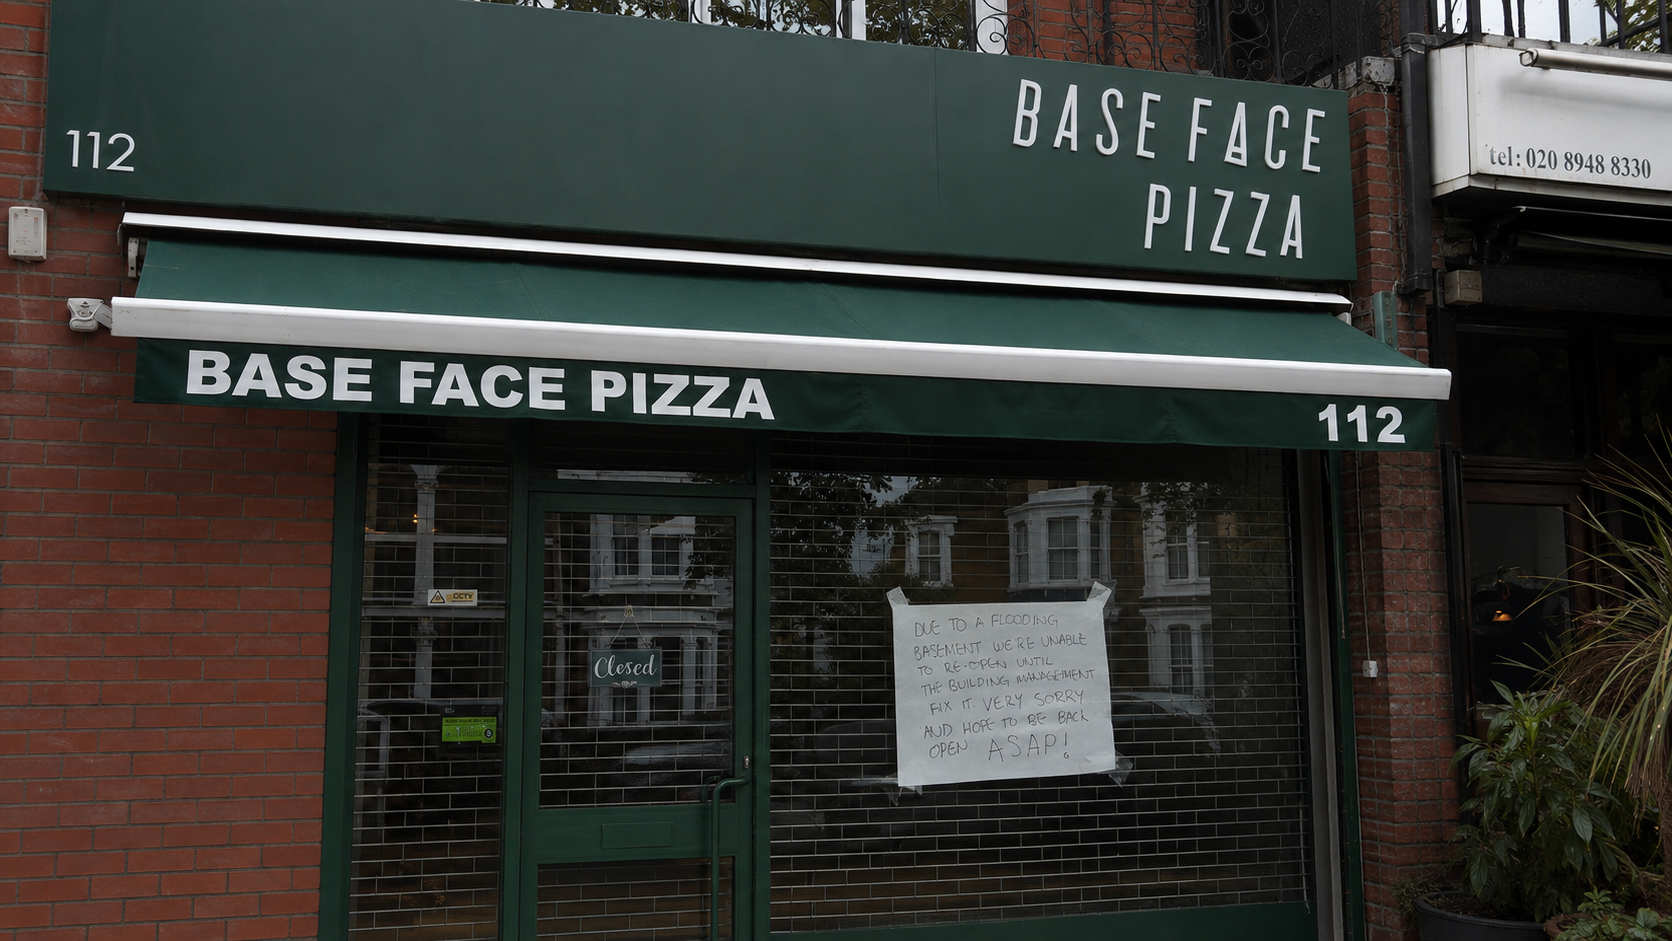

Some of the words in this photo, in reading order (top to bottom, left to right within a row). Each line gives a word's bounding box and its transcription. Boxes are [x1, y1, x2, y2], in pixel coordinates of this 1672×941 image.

[1012, 78, 1162, 159] BASE
[1188, 97, 1326, 173] FACE
[66, 129, 135, 172] 112
[1525, 147, 1558, 170] 020
[1564, 151, 1605, 175] 8948
[1610, 156, 1652, 179] 8330
[1144, 183, 1304, 259] PIZZA
[186, 349, 373, 402] BASE
[399, 360, 566, 411] FACE
[591, 369, 775, 420] PIZZA
[1318, 403, 1406, 444] 112
[914, 620, 940, 637] DUE
[950, 618, 967, 632] TO
[975, 617, 984, 628] A
[991, 614, 1058, 627] FLOODING
[914, 642, 981, 660] BASEMENT
[993, 637, 1034, 651] WE'RE
[1041, 633, 1087, 647] UNABLE
[594, 654, 657, 679] Closed
[918, 666, 933, 676] TO
[1017, 657, 1053, 667] UNTIL
[921, 684, 943, 696] THE
[949, 676, 1010, 692] BUILDING
[1016, 669, 1096, 684] MANAGEMENT
[930, 700, 952, 715] FIX
[983, 694, 1023, 711] VERY
[1034, 690, 1084, 707] SORRY
[923, 723, 952, 739] AND
[963, 718, 994, 734] HOPE
[1001, 717, 1017, 728] TO
[1028, 713, 1046, 726] BE
[1057, 710, 1089, 722] BACK
[928, 740, 968, 759] OPEN
